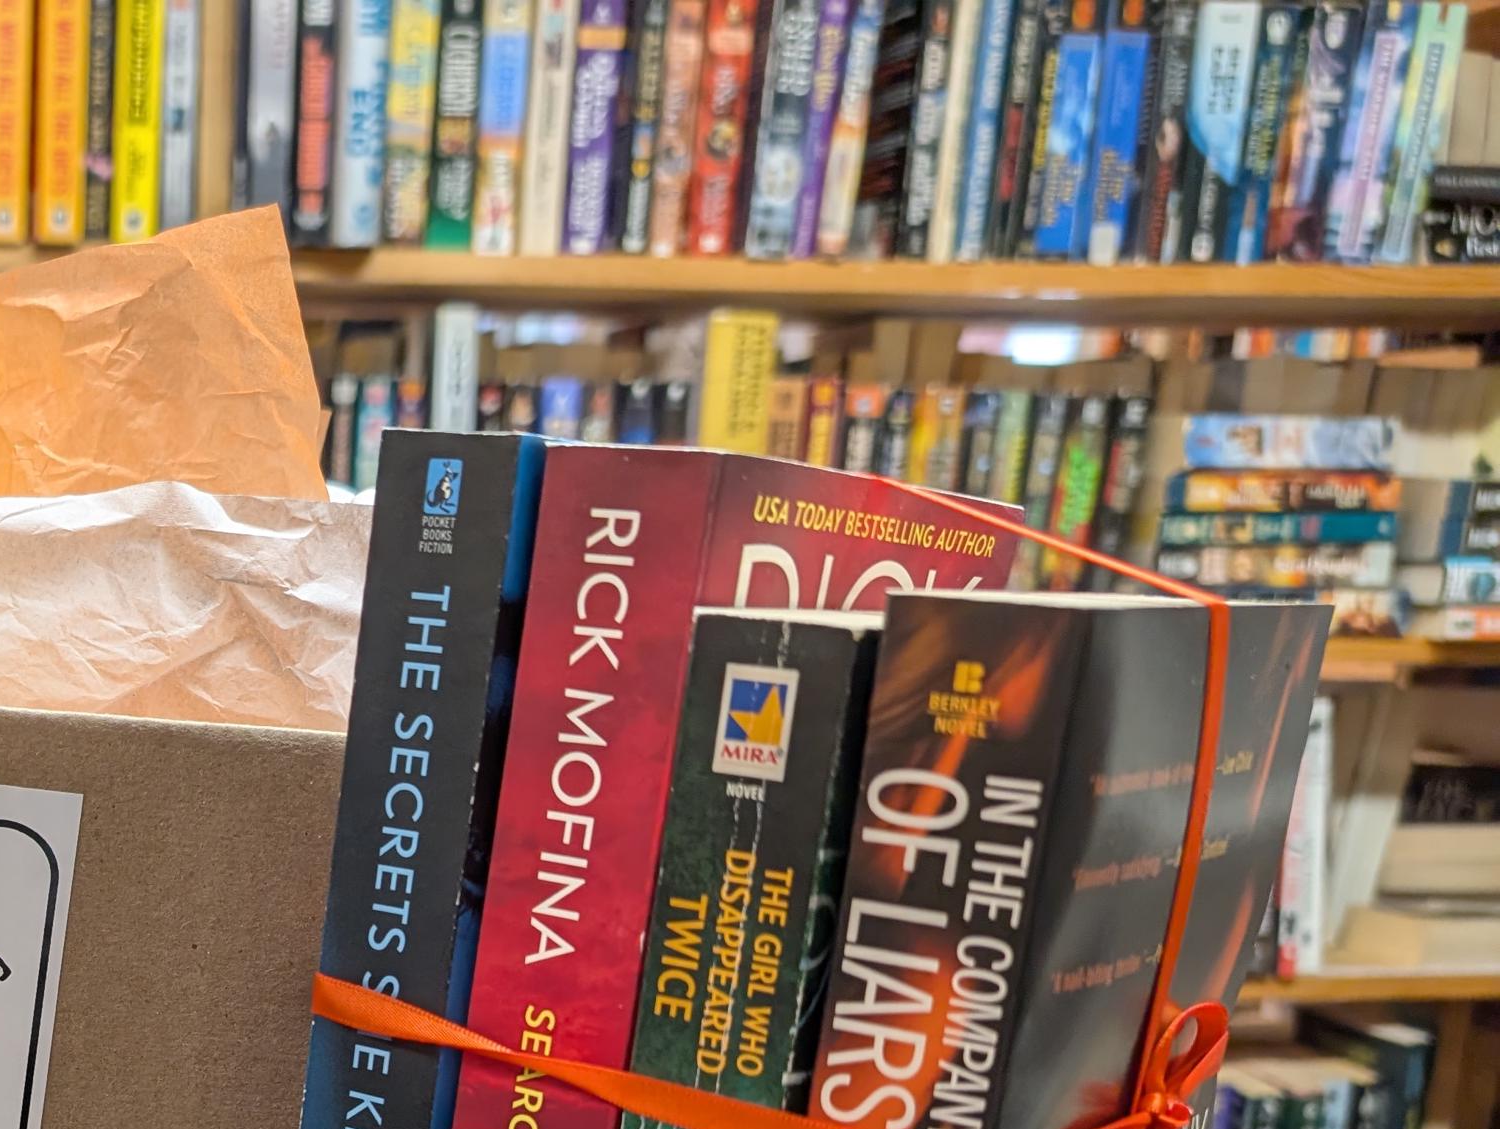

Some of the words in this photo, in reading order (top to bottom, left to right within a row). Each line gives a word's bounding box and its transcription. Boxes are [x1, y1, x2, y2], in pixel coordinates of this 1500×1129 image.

[419, 540, 454, 555] FICTION
[421, 515, 456, 529] POCKET
[422, 528, 453, 542] BOOKS
[753, 494, 789, 526] USA
[794, 500, 846, 533] TODAY
[844, 510, 937, 550] BESTSELLING
[934, 528, 997, 559] AUTHOR
[568, 506, 641, 671] RICK
[399, 585, 452, 692] THE
[721, 743, 779, 766] MIRA
[933, 715, 987, 740] NOVEL
[523, 687, 616, 966] MOFINA
[725, 780, 765, 803] NOVEL
[979, 773, 1044, 830] IN
[366, 712, 434, 955] SECRETS
[861, 767, 971, 888] OF
[761, 866, 794, 928] THE
[962, 837, 1034, 931] THE
[654, 893, 710, 1023] TWICE
[695, 848, 757, 1076] DISAPPEARED
[745, 932, 782, 1000] GIRL
[351, 970, 401, 1075] SE
[735, 1003, 773, 1078] WHO
